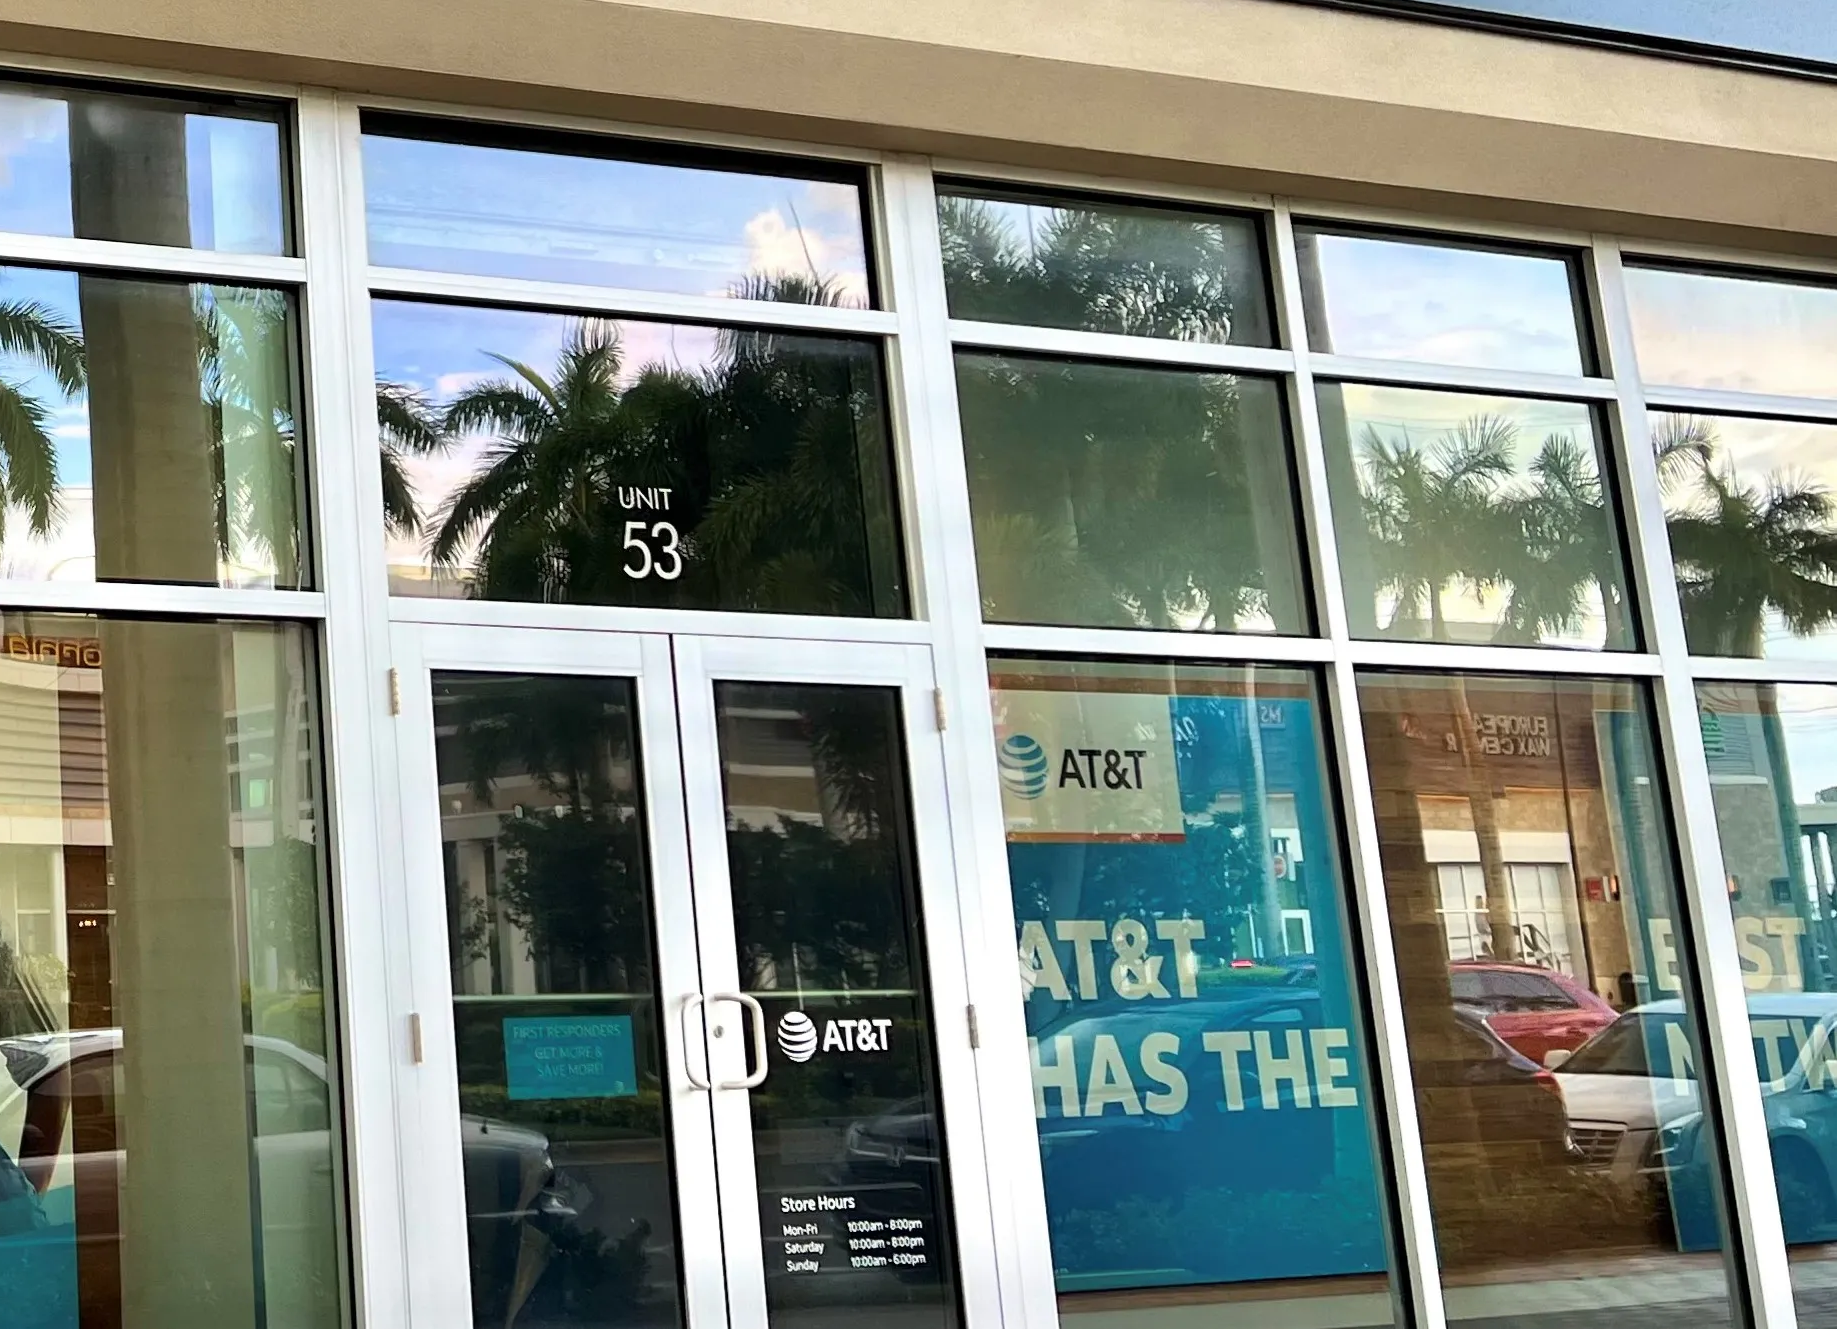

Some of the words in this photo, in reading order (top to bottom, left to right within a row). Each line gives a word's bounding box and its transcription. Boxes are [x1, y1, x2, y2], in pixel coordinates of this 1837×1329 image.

[618, 486, 672, 510] UNIT
[623, 521, 682, 580] 53
[1059, 749, 1147, 789] AT&T
[1020, 919, 1205, 1000] AT&T
[513, 1026, 543, 1039] FIRST
[546, 1024, 621, 1038] RESPONDERS
[823, 1019, 892, 1052] AT&T
[534, 1047, 557, 1059] GET
[560, 1046, 594, 1058] MORE
[537, 1064, 565, 1076] SAVE
[1028, 1032, 1189, 1119] HAS
[1202, 1028, 1358, 1112] THE
[781, 1197, 816, 1213] Store
[818, 1195, 856, 1211] Hours
[782, 1223, 819, 1236] Mon-Fri
[847, 1221, 884, 1233] 10:00am
[890, 1218, 923, 1232] 8:00pm
[784, 1241, 825, 1255] Saturday
[849, 1238, 886, 1250] 10:00am
[891, 1236, 925, 1249] 8:00pm
[786, 1259, 820, 1273] Sunday
[850, 1255, 887, 1268] 10:00am
